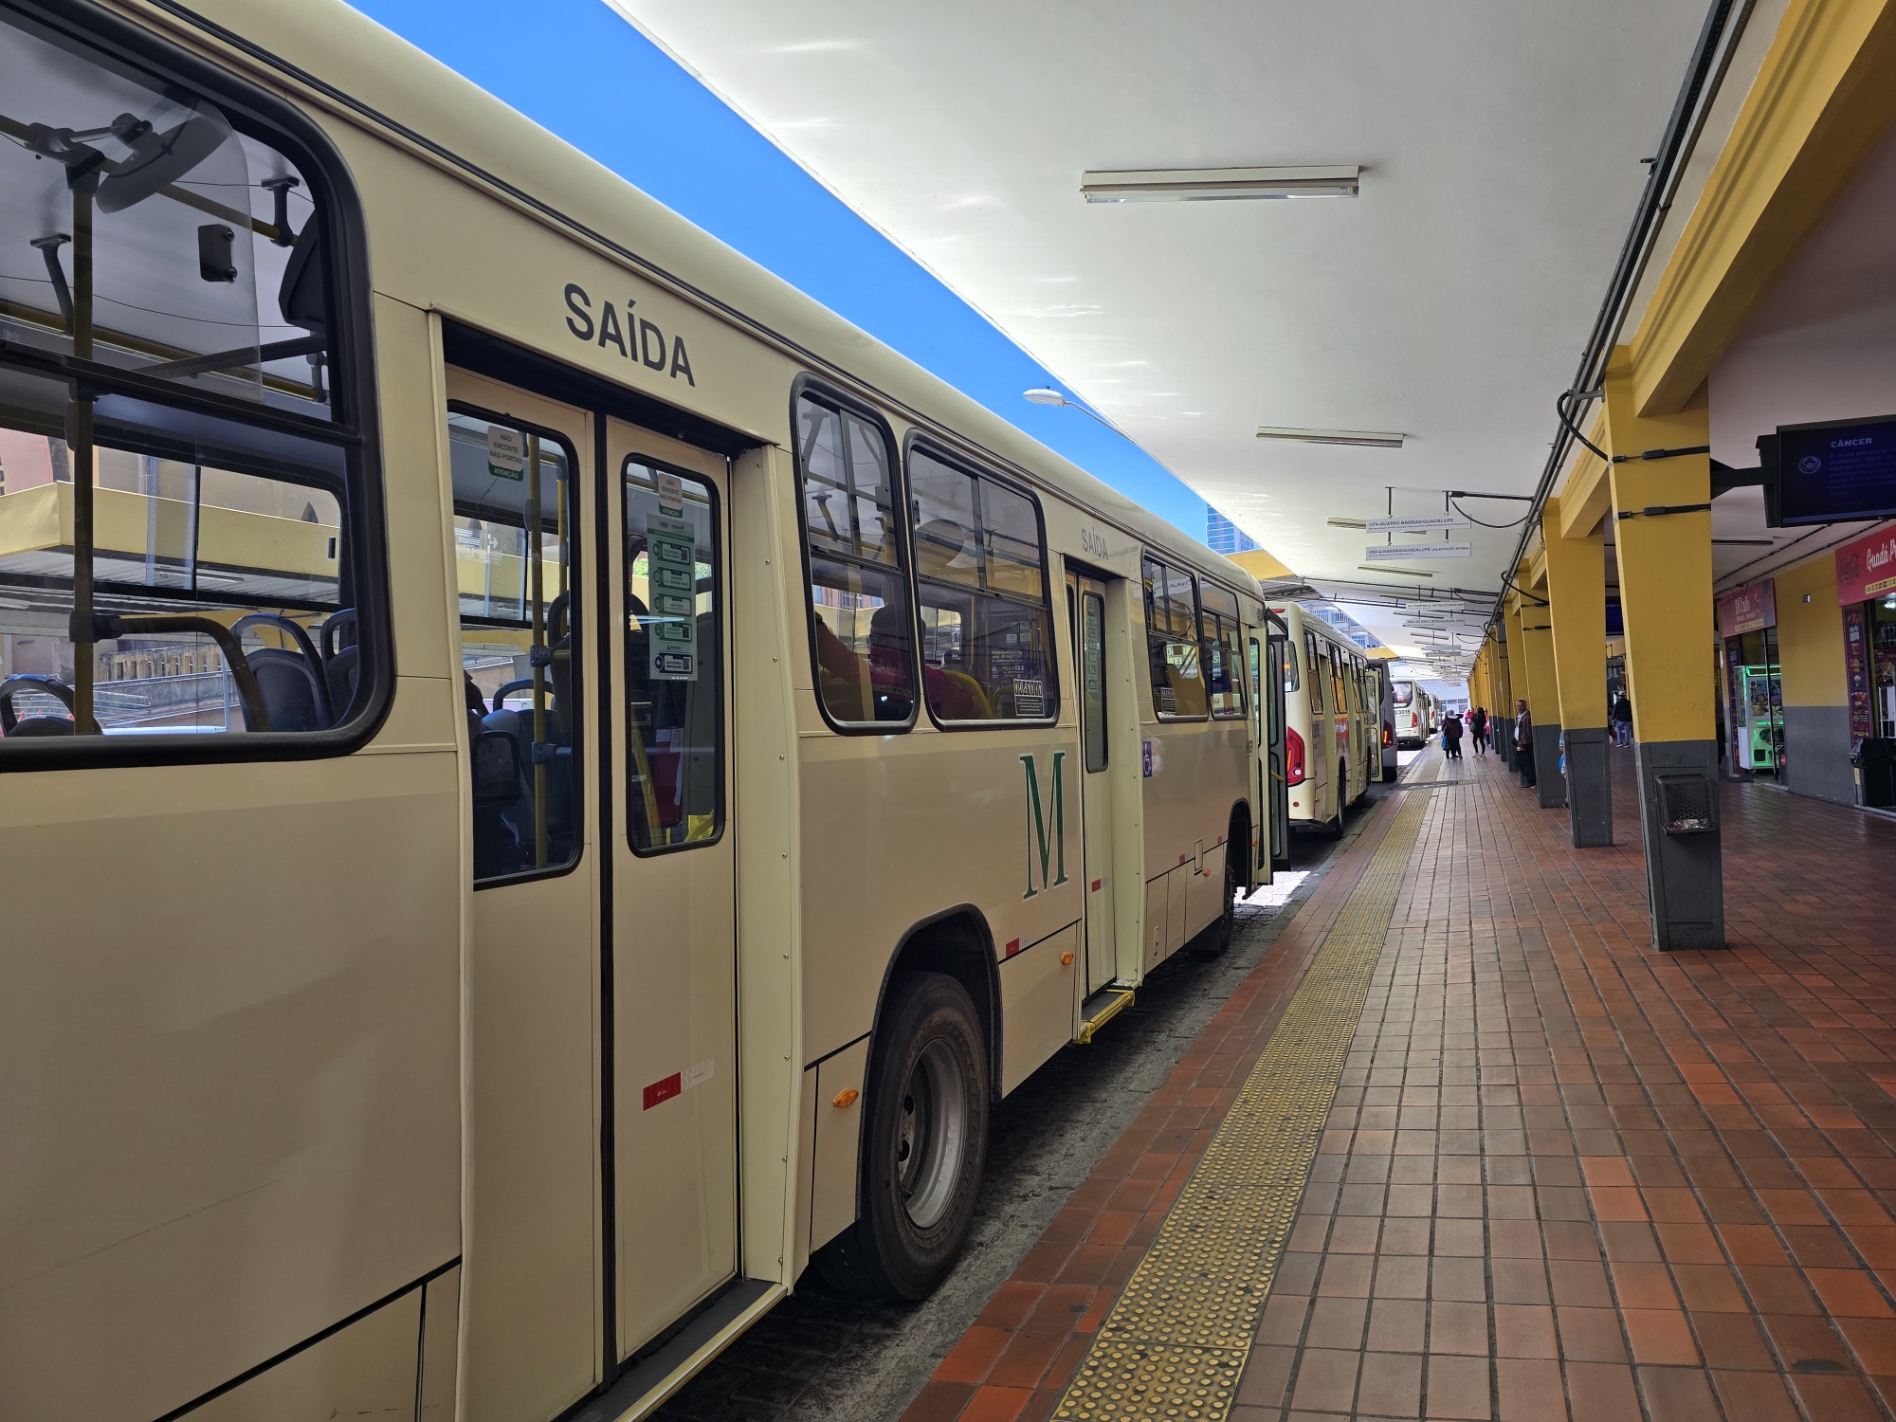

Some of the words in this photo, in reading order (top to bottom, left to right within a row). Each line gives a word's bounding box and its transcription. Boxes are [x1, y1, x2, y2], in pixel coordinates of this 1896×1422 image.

[564, 283, 696, 388] SAÍDA
[500, 433, 512, 442] NÃO
[1831, 438, 1872, 448] CÂNCER
[493, 441, 519, 454] ENCOSTE
[489, 450, 501, 459] NAS
[501, 453, 523, 465] PORTAS
[493, 467, 519, 479] ATENÇÃO
[661, 486, 679, 495] ENCOSTE
[662, 507, 680, 517] ATENÇÃO
[1081, 526, 1109, 561] SAÍDA
[1019, 751, 1069, 901] M
